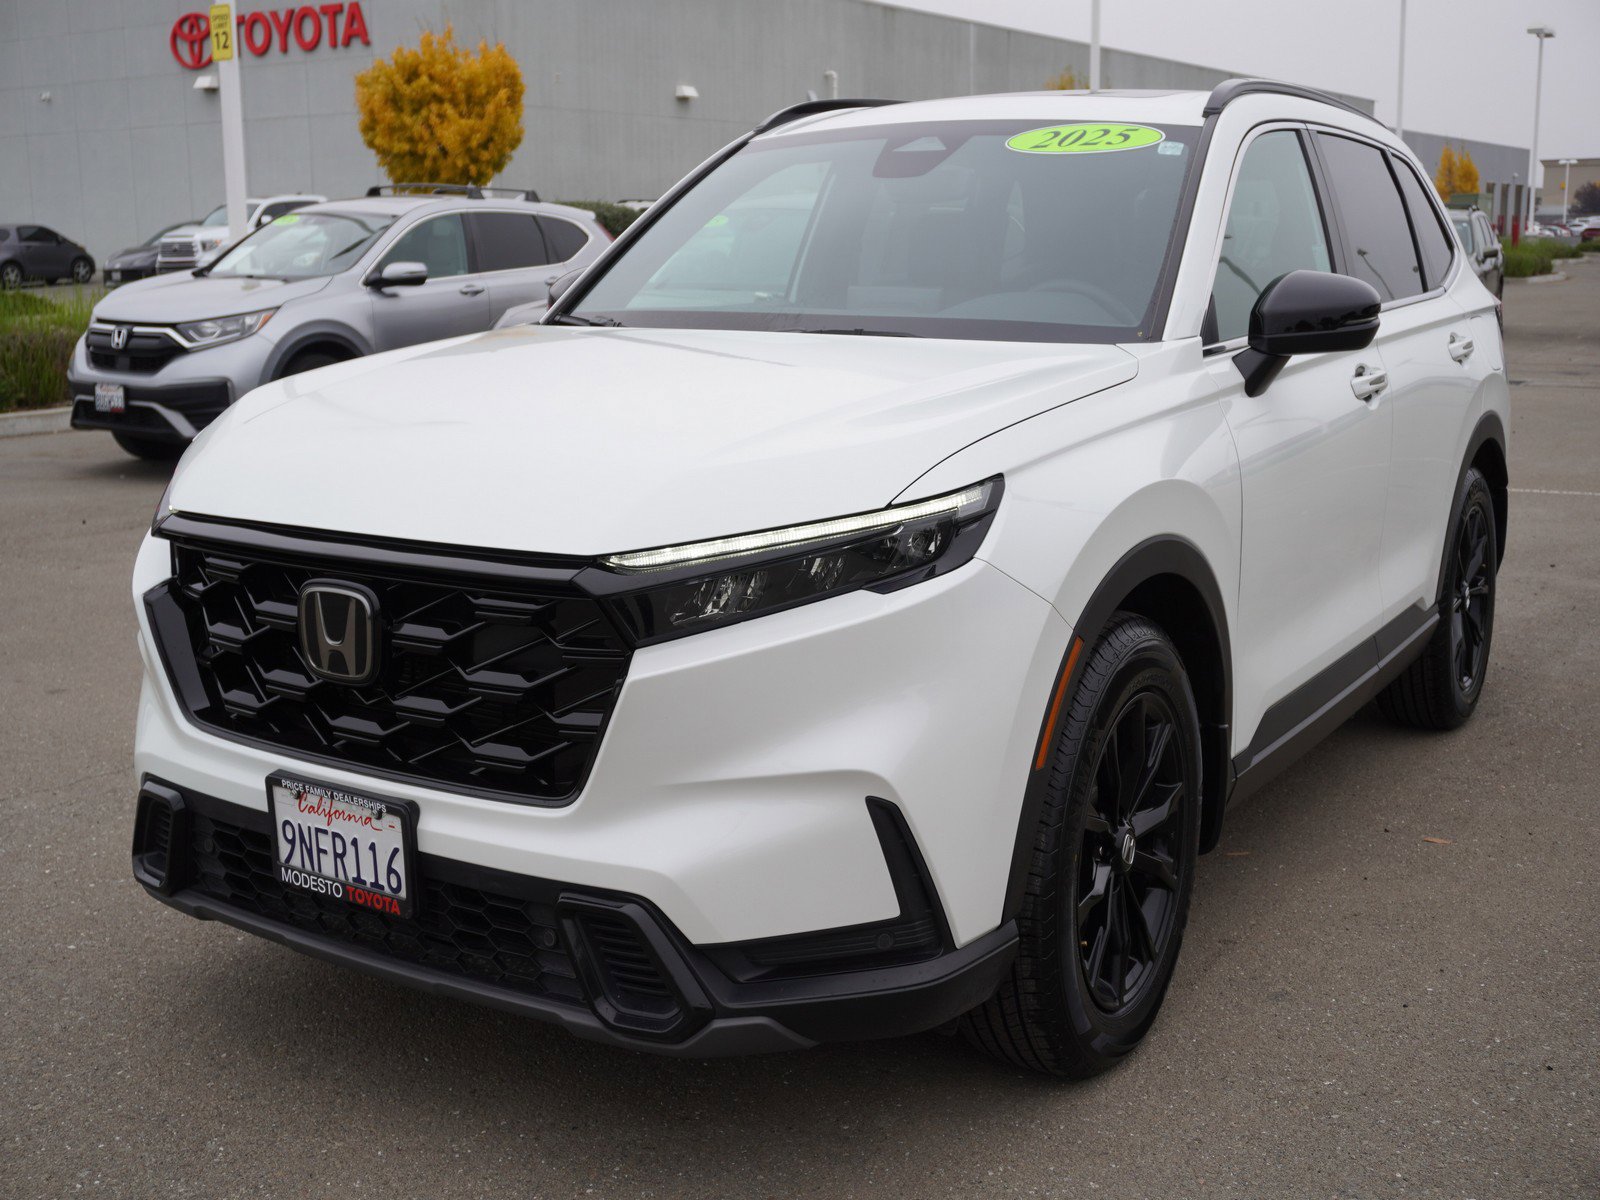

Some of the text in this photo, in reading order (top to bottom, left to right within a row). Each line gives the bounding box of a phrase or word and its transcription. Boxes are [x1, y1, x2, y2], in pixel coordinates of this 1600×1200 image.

[214, 31, 229, 50] 12
[1029, 128, 1140, 150] 2025
[281, 779, 387, 813] PRICE FAMILY DEALERSHIPS
[297, 790, 383, 831] California
[281, 819, 402, 895] 9NFR116
[281, 866, 401, 916] MODESTO TOYOTA
